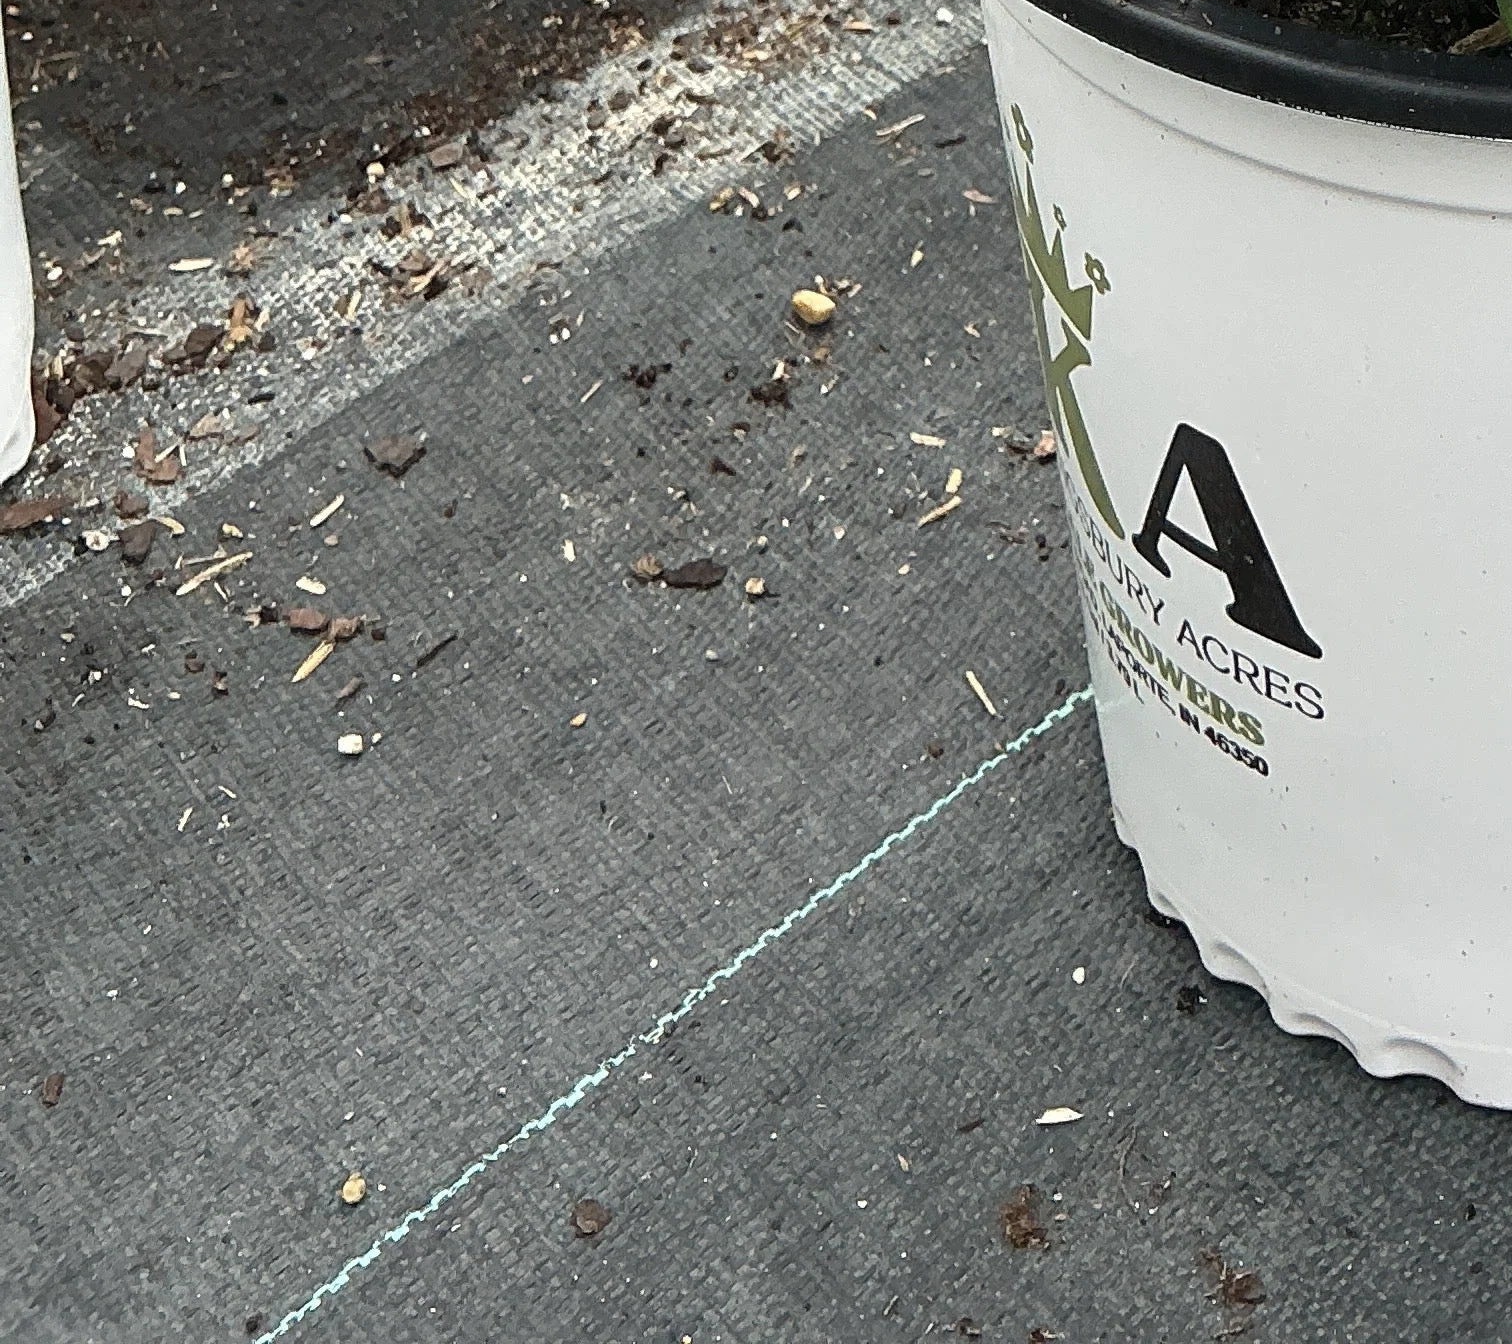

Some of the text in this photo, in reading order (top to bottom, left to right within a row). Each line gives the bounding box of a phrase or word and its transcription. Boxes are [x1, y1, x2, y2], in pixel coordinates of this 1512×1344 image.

[1100, 580, 1266, 747] GROWERS
[1176, 617, 1325, 720] ACRES
[1178, 702, 1201, 734] IN
[1203, 725, 1269, 777] 46350
